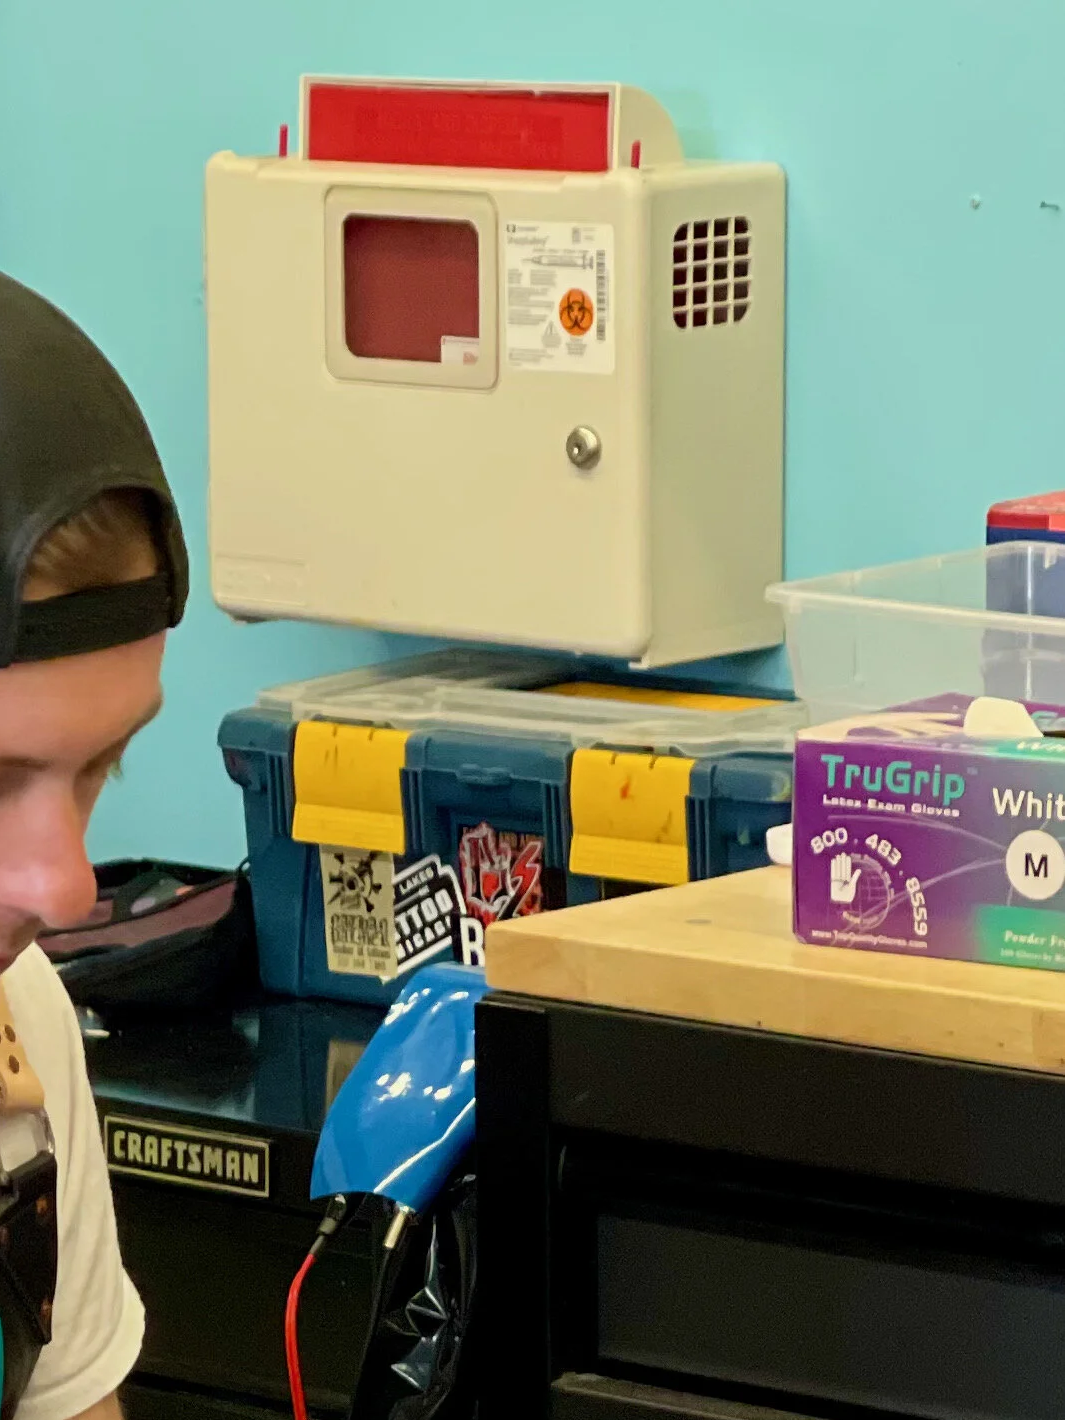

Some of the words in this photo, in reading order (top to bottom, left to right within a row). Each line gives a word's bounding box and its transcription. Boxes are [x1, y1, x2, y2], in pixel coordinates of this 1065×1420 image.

[821, 754, 965, 806] TruGrip
[823, 794, 862, 810] Latex
[867, 798, 905, 814] Exam
[911, 802, 960, 818] Gloves
[810, 827, 848, 855] 800
[865, 833, 902, 866] 483
[398, 866, 434, 896] LAKES
[1024, 852, 1048, 878] M
[113, 1130, 260, 1184] CRAFTSMAN
